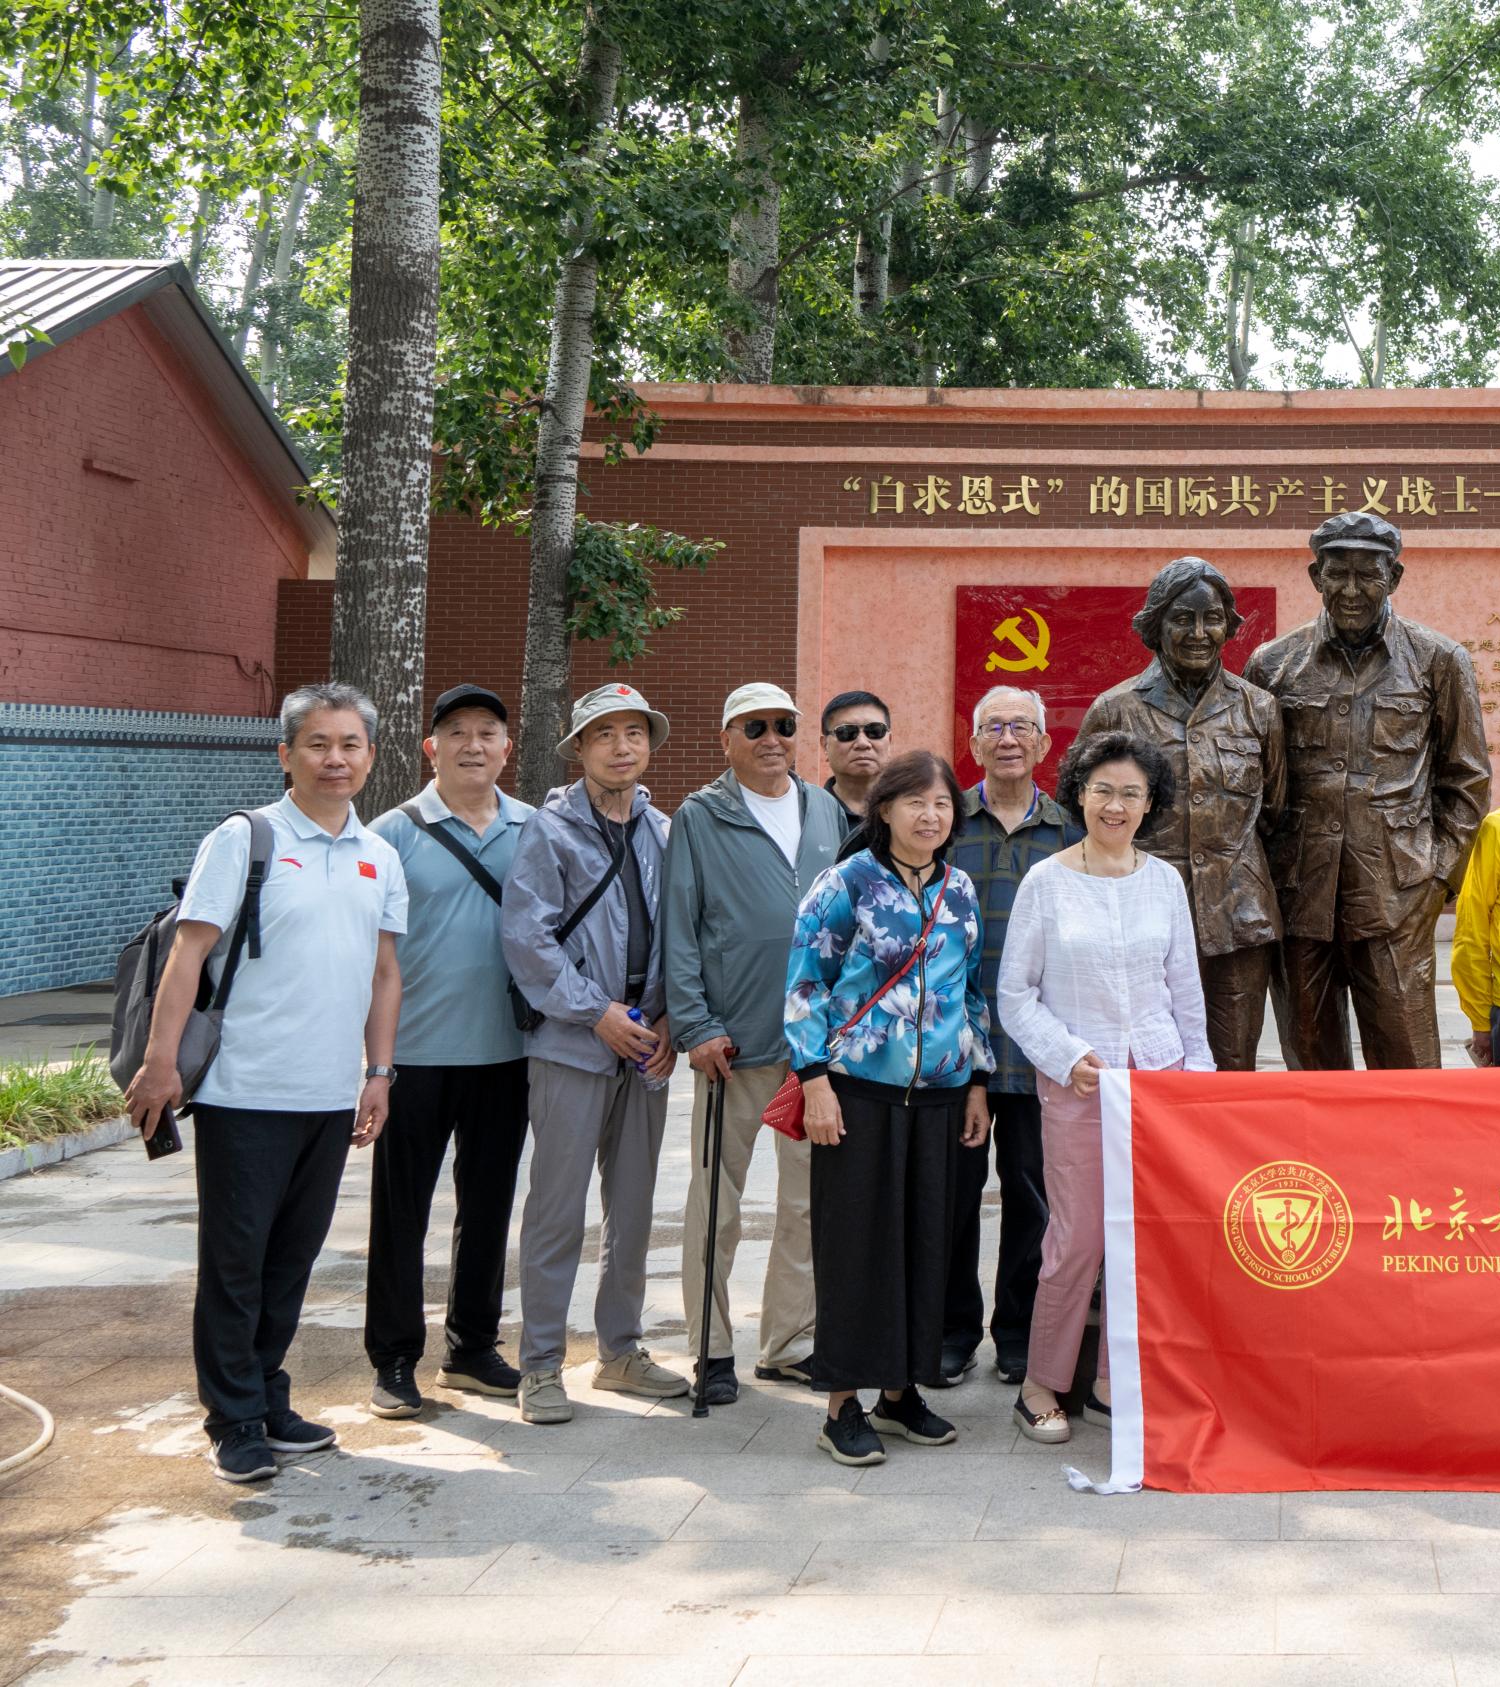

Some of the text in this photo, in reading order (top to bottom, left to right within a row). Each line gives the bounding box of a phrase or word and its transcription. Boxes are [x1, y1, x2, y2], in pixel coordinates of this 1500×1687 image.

[1242, 1166, 1332, 1195] 北京大学公共卫生学院
[1279, 1180, 1299, 1188] 1931
[1230, 1199, 1346, 1283] PEKING UNIVERSITY SCHOOL OF PUBLIC HEALTH
[1382, 1255, 1460, 1273] PEKING
